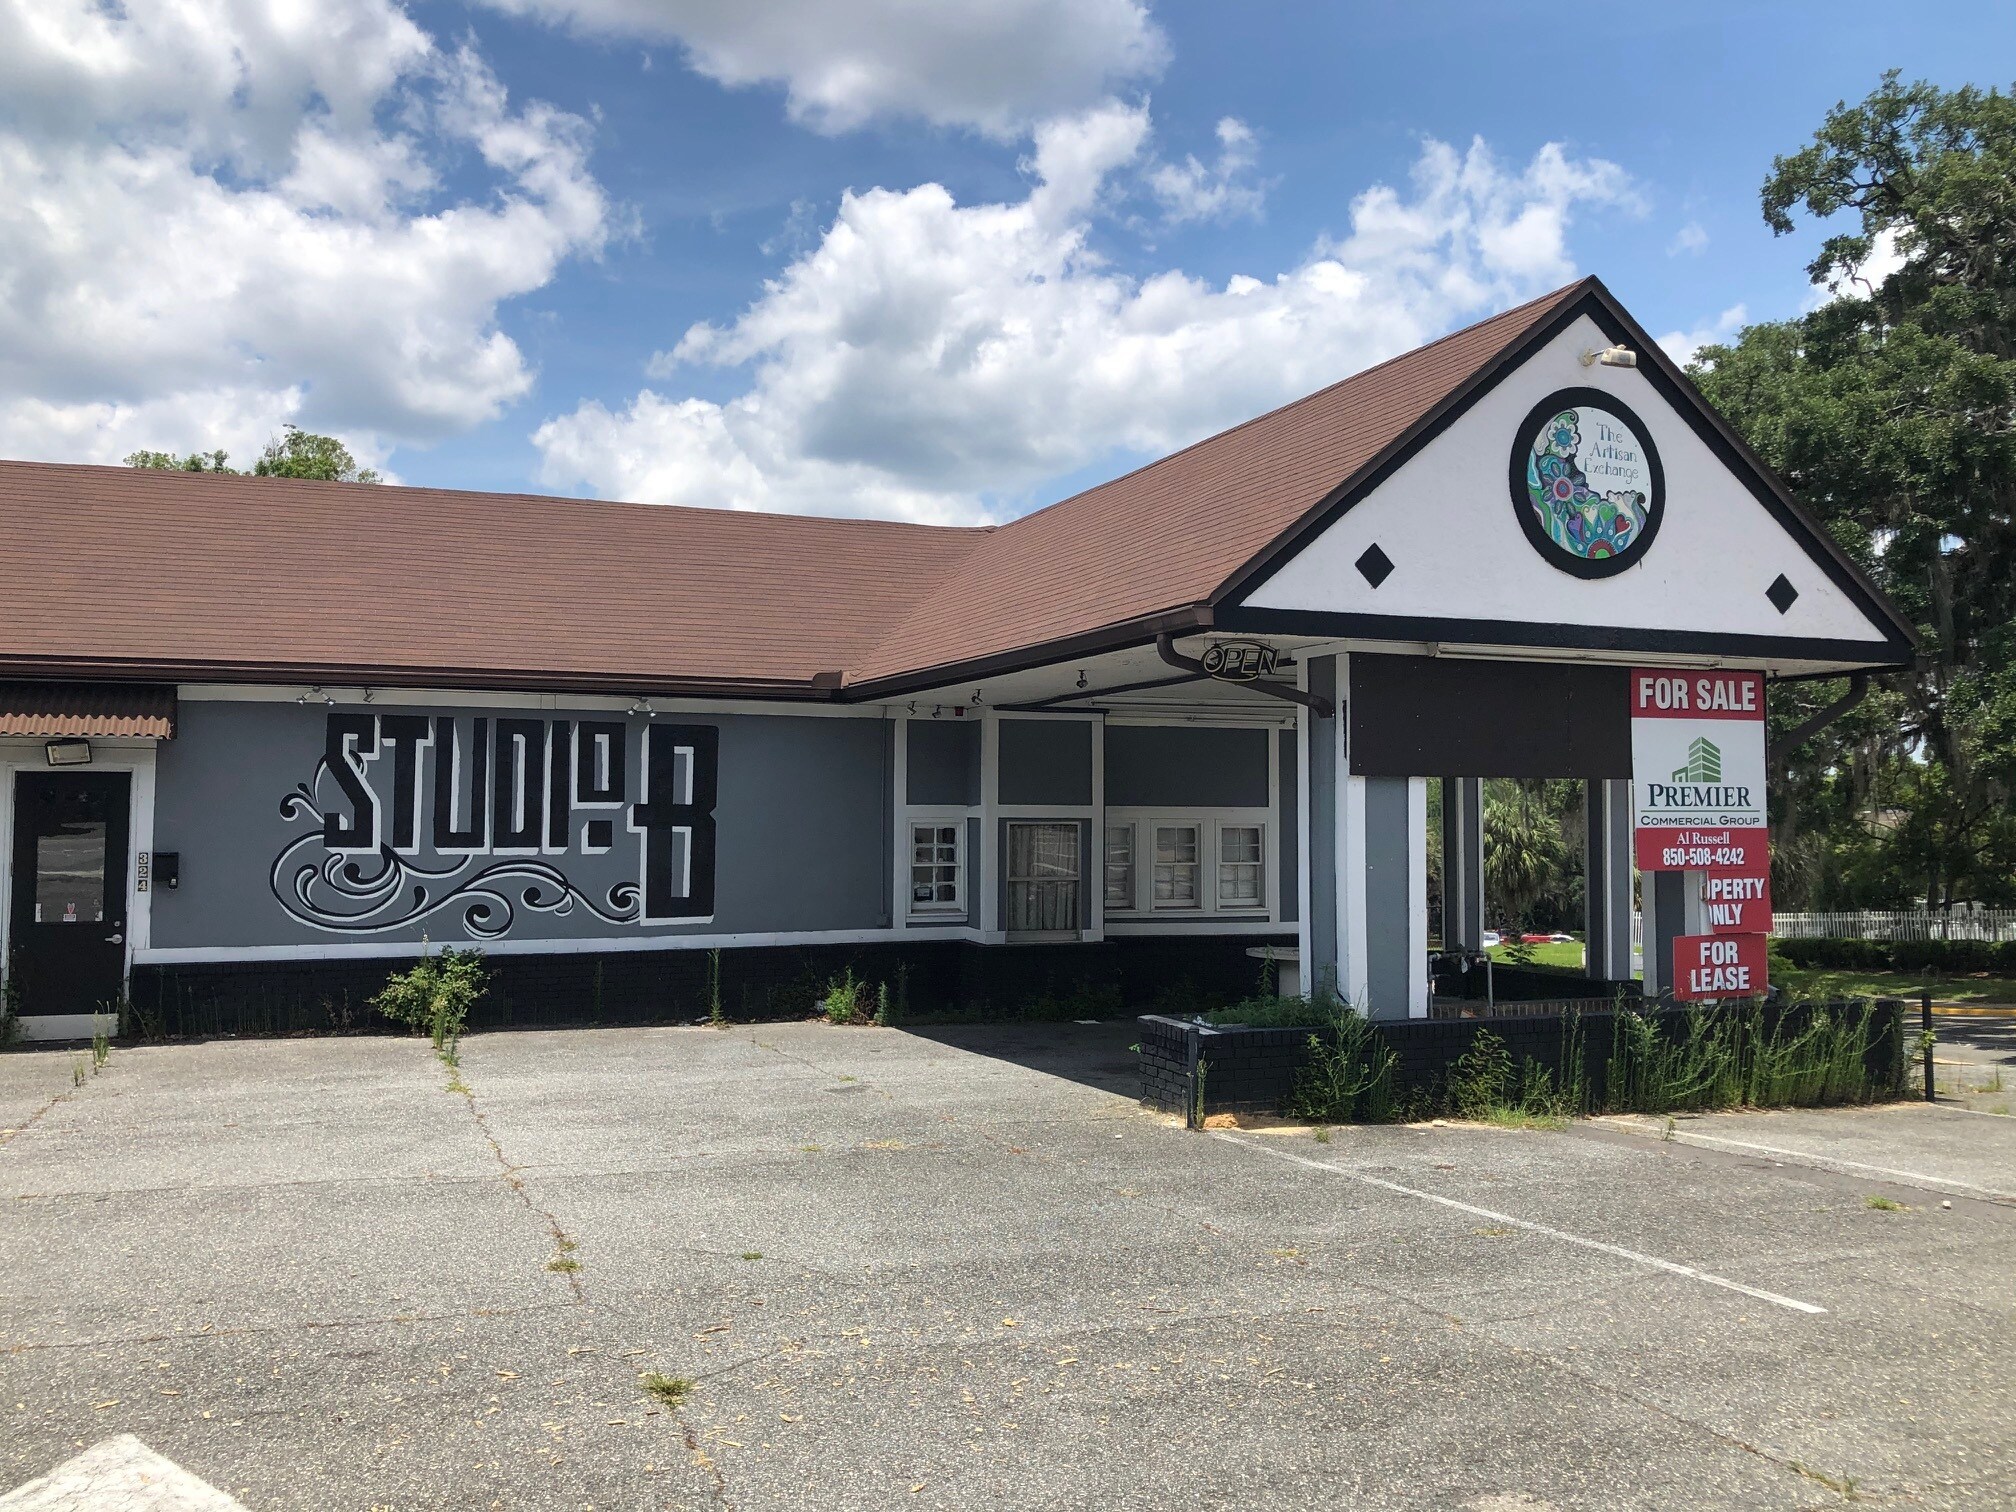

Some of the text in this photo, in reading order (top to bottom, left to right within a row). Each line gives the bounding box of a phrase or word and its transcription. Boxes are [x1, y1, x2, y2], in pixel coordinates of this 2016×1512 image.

[1596, 422, 1623, 443] The
[1589, 442, 1637, 463] Artisan
[1584, 457, 1639, 484] Exchange
[1203, 645, 1279, 674] OPEN
[1639, 677, 1756, 711] FOR SALE
[1647, 783, 1752, 807] PREMIER
[626, 722, 720, 926] B
[1640, 815, 1760, 826] COMMERCIAL GROUP
[1677, 831, 1730, 845] Al Russell
[1662, 847, 1745, 866] 850-508-4242
[1709, 903, 1743, 925] NLY
[1700, 941, 1739, 965] FOR
[1690, 966, 1750, 993] LEASE
